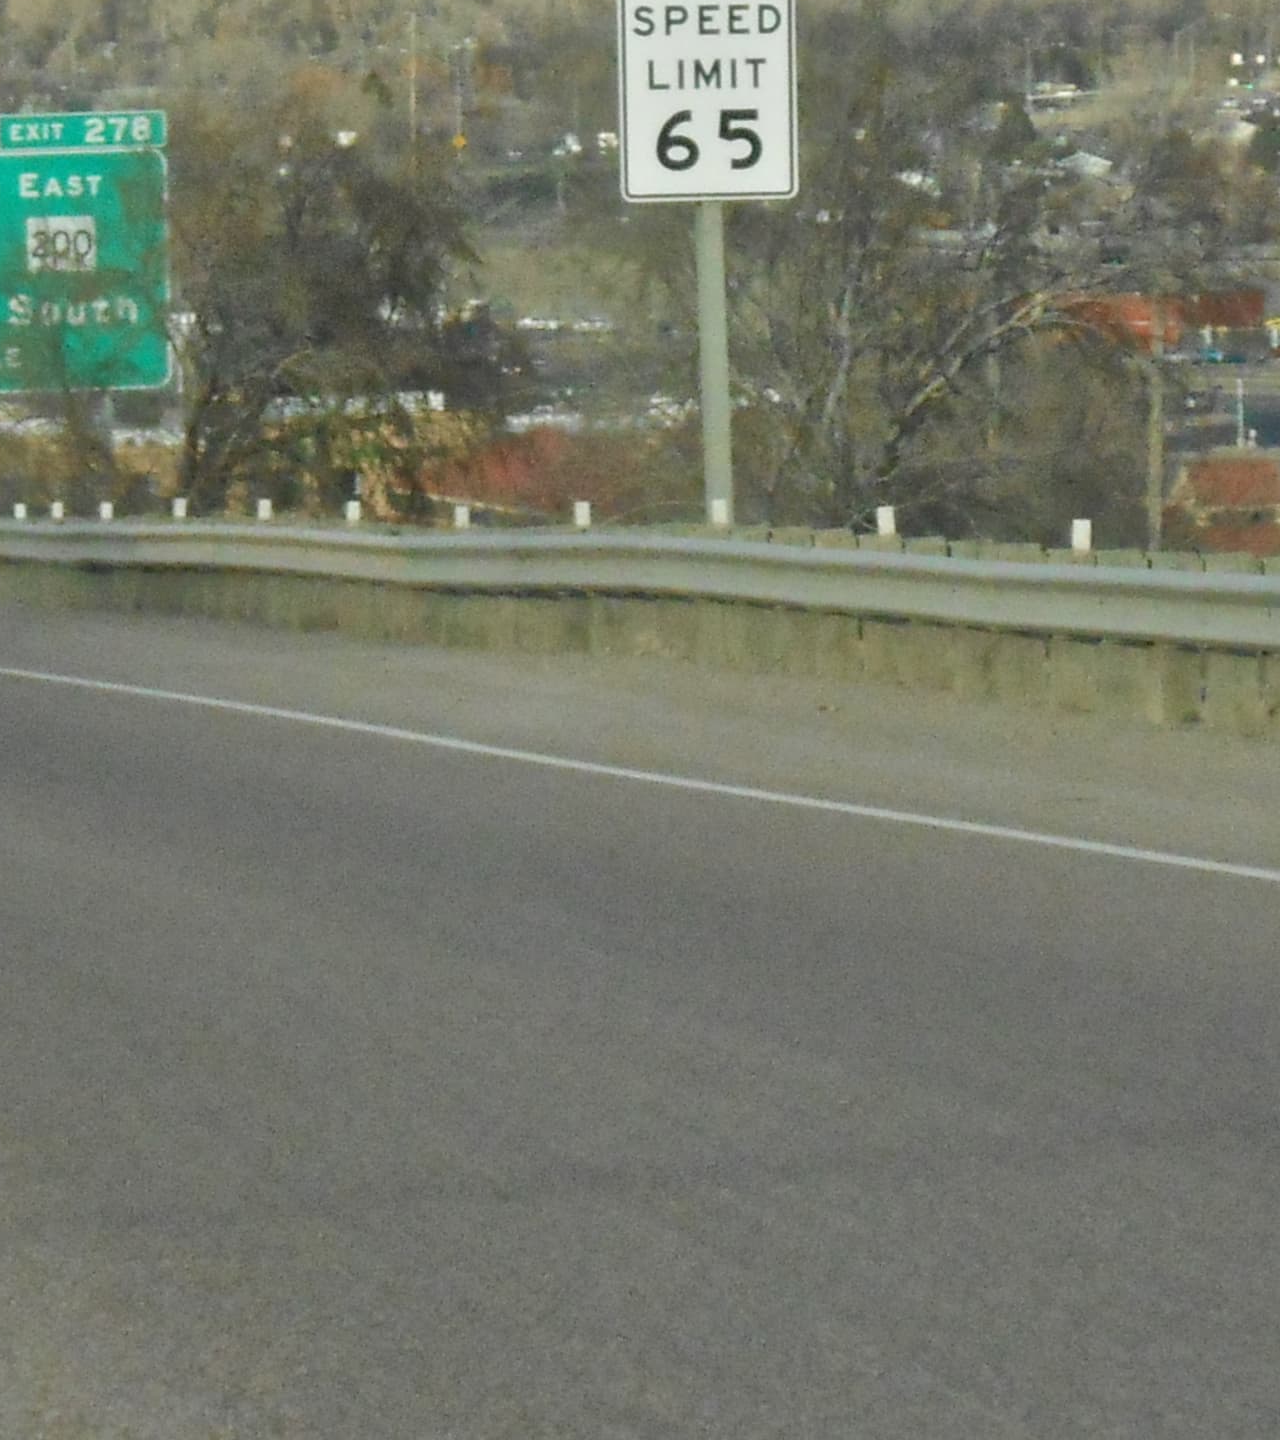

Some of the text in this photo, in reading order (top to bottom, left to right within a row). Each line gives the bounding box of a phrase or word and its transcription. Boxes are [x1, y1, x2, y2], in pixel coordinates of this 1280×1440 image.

[633, 4, 781, 36] SPEED
[648, 58, 766, 90] LIMIT
[10, 116, 151, 143] EXIT 278
[656, 109, 762, 171] 65
[19, 173, 102, 198] EAST
